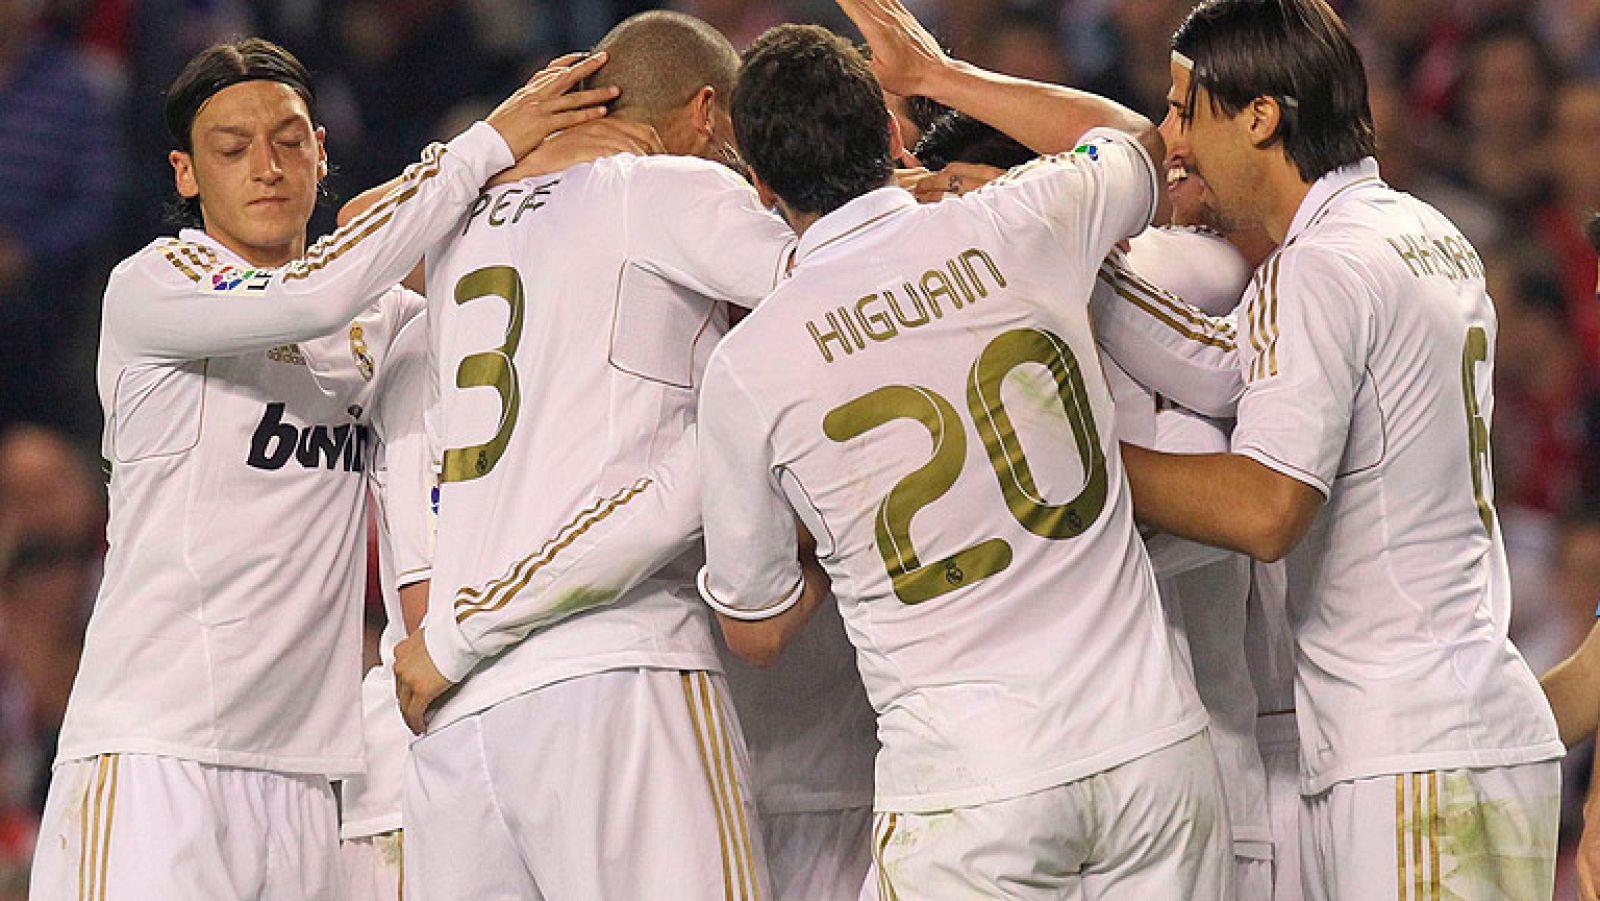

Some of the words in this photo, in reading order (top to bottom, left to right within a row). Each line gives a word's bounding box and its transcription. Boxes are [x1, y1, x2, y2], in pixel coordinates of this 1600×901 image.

[443, 265, 525, 482] 3
[806, 248, 1006, 363] HIGUAIN
[823, 327, 1107, 605] 20
